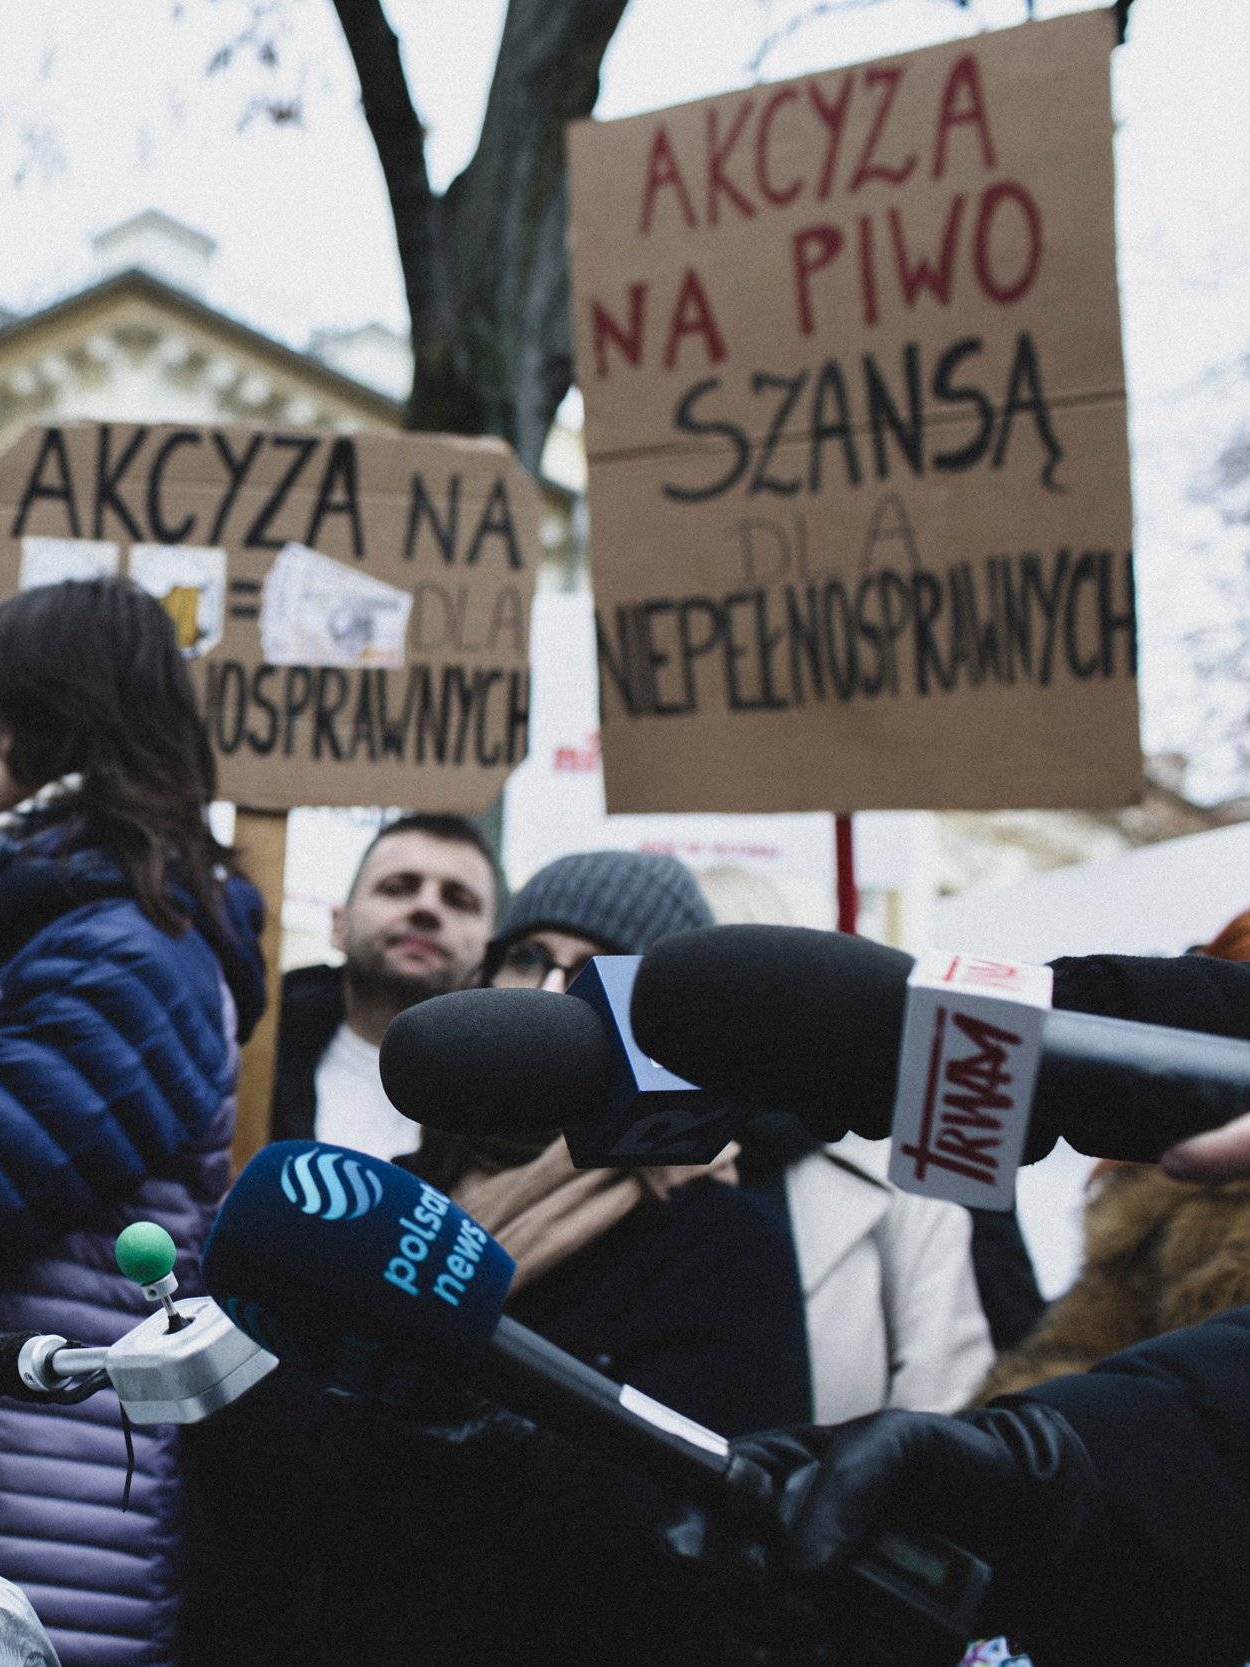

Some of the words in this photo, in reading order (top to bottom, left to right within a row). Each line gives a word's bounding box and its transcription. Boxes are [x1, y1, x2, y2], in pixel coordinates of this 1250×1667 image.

[639, 50, 996, 234] AKCYZA
[590, 268, 728, 378] NA
[793, 180, 1042, 335] PIWO
[661, 331, 1065, 503] SZANSĄ
[12, 425, 365, 559] AKCYZA
[403, 471, 523, 570] NA
[736, 494, 920, 580] DLA
[414, 581, 525, 653] DLA
[596, 548, 1138, 722] NIEPEŁNOSPRAWNYCH
[901, 1006, 1022, 1186] TRWAM
[383, 1183, 451, 1297] polsat
[433, 1218, 488, 1306] news
